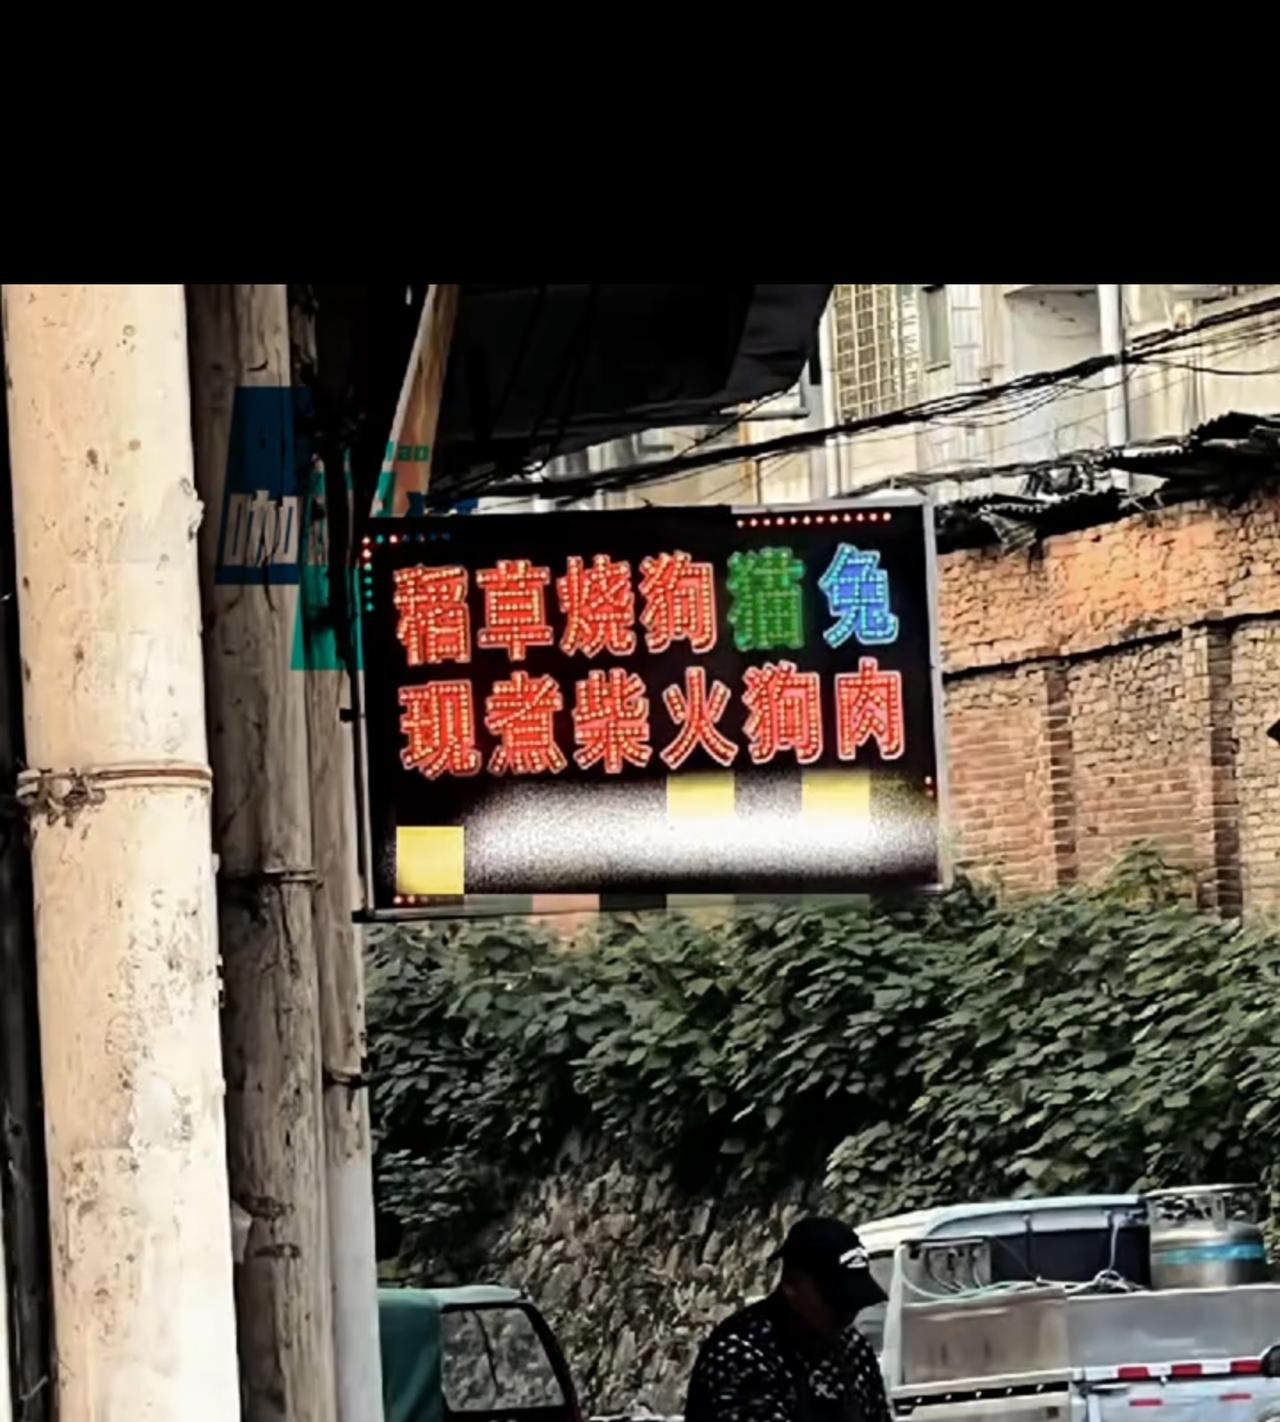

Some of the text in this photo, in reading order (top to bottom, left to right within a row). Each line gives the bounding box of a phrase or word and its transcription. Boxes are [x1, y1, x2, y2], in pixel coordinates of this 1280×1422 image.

[393, 544, 899, 666] 稻草烧狗猫兔
[400, 658, 907, 779] 现煮柴火狗肉
